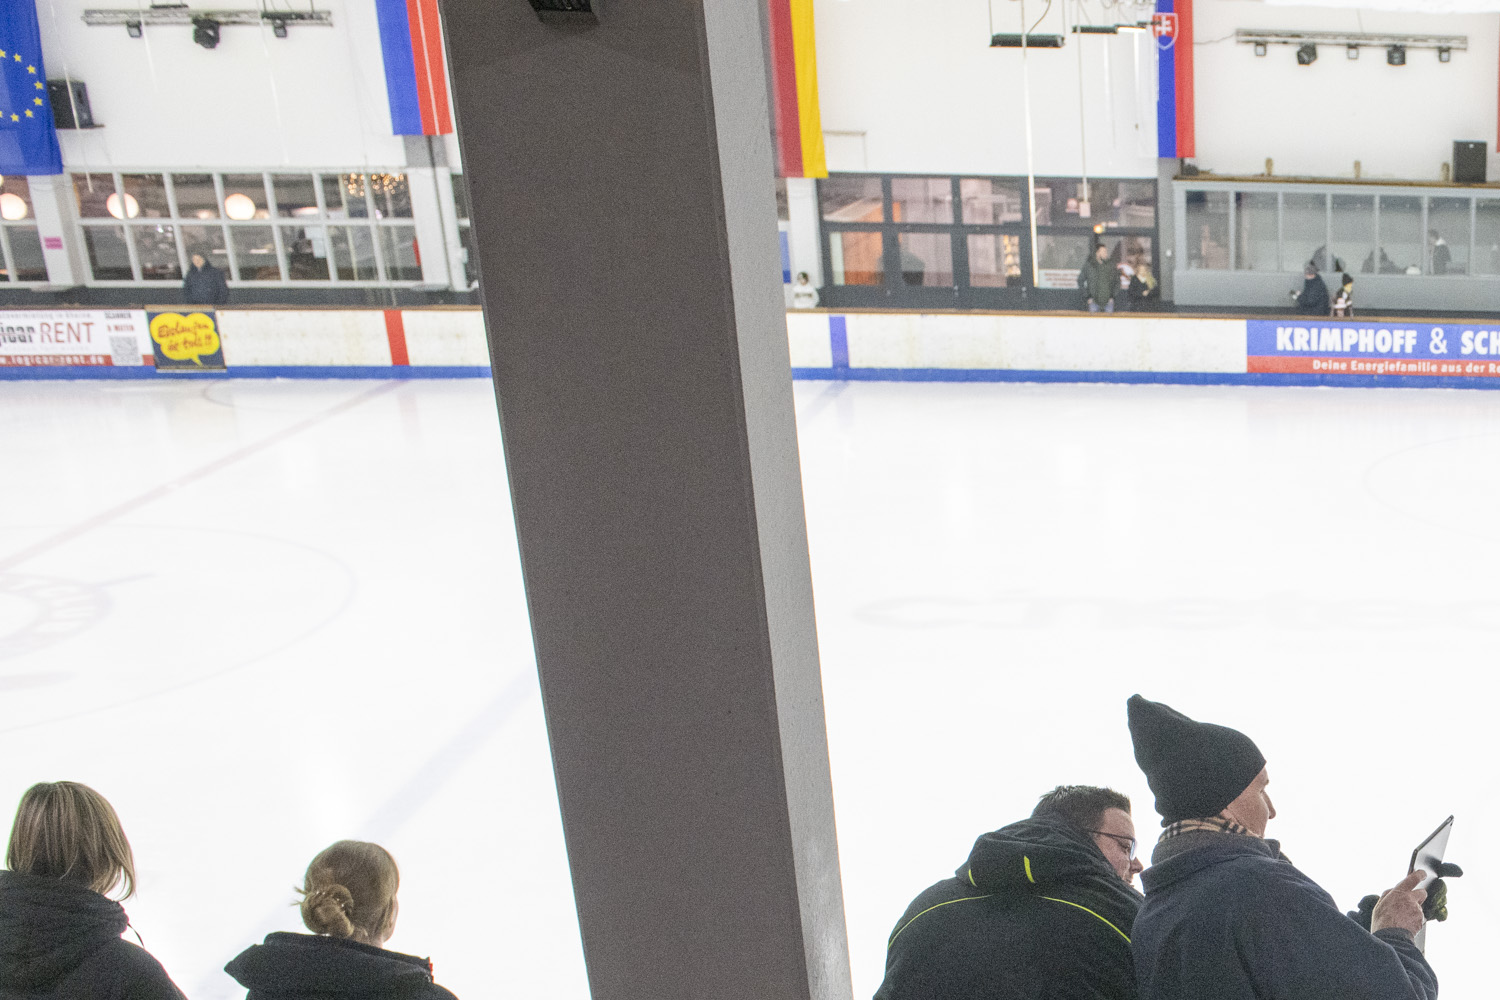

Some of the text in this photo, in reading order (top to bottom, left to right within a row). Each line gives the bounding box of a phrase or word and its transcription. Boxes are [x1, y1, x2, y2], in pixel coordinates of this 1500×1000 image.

[40, 322, 95, 343] RENT
[1276, 326, 1417, 353] KRIMPHOFF
[1429, 327, 1448, 355] &
[1312, 359, 1347, 371] Deine
[1350, 360, 1438, 374] Energiefamilie
[1440, 363, 1462, 374] aus
[1465, 362, 1486, 374] der
